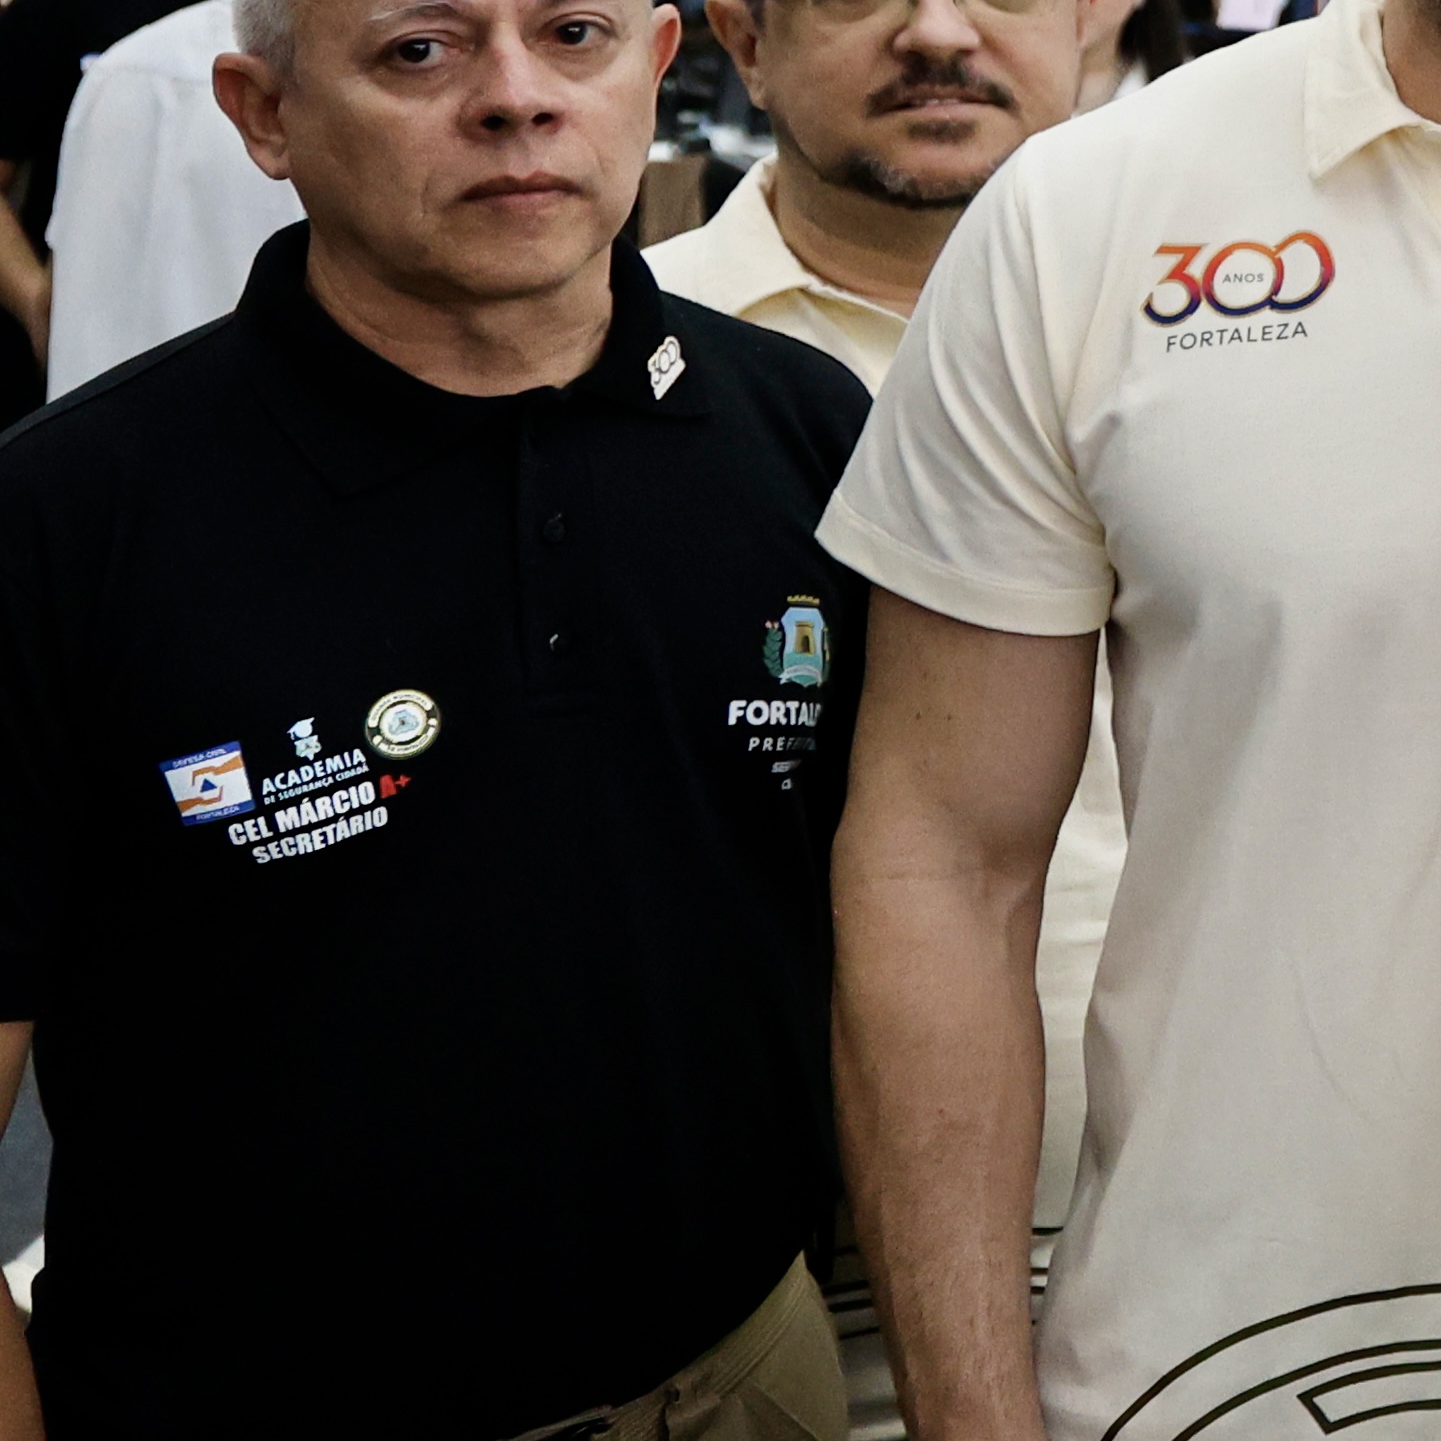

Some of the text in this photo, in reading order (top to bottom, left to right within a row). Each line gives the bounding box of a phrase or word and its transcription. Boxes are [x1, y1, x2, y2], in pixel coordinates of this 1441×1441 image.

[1140, 229, 1336, 327] 300
[1222, 273, 1265, 284] ANOS
[1165, 321, 1308, 353] FORTALEZA
[262, 748, 367, 795] ACADEMIA
[264, 796, 276, 805] DE
[277, 776, 335, 801] SEGURANÇA
[228, 816, 274, 846] CEL
[275, 781, 376, 833] MÁRCIO
[252, 806, 388, 864] SECRETÁRIO
